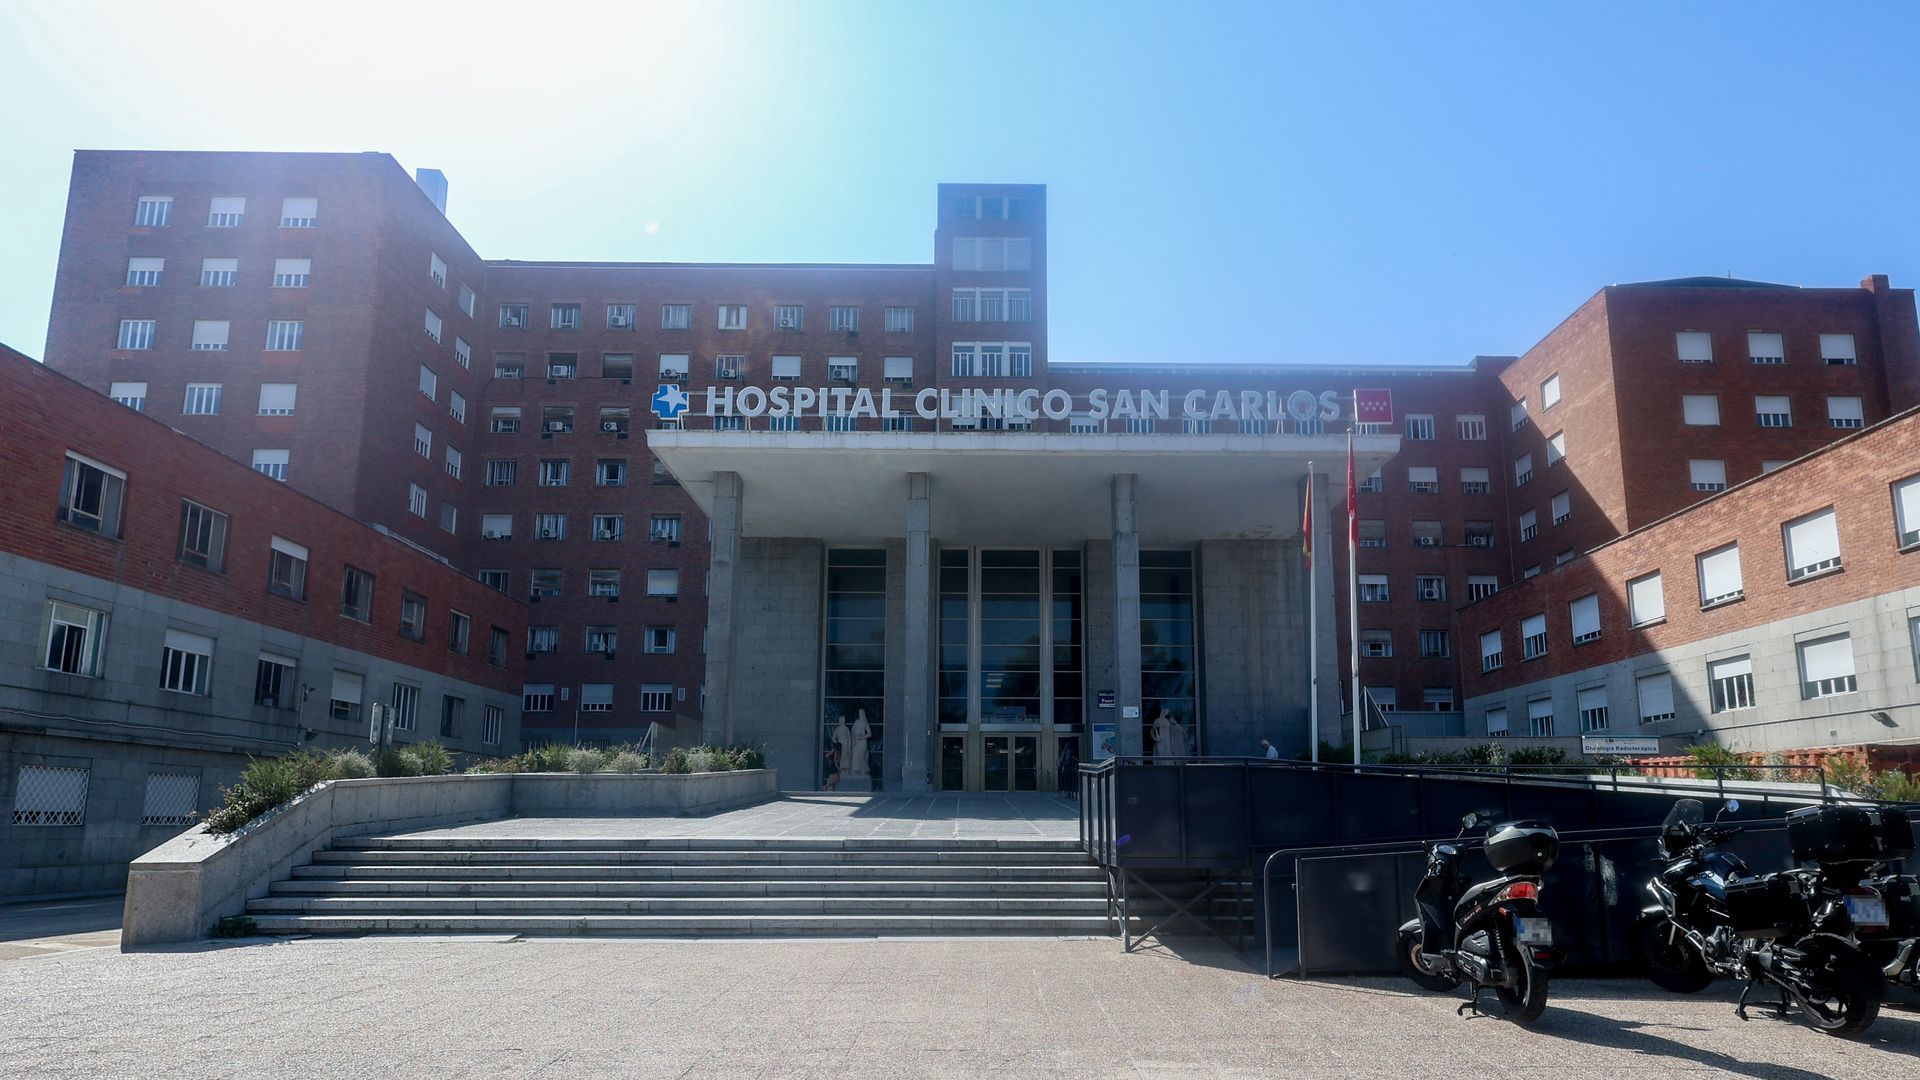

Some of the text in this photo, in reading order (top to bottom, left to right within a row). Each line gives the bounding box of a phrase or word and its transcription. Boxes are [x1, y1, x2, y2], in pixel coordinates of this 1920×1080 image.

[706, 385, 1341, 422] HOSPITAL CLINICO SAN CARLOS
